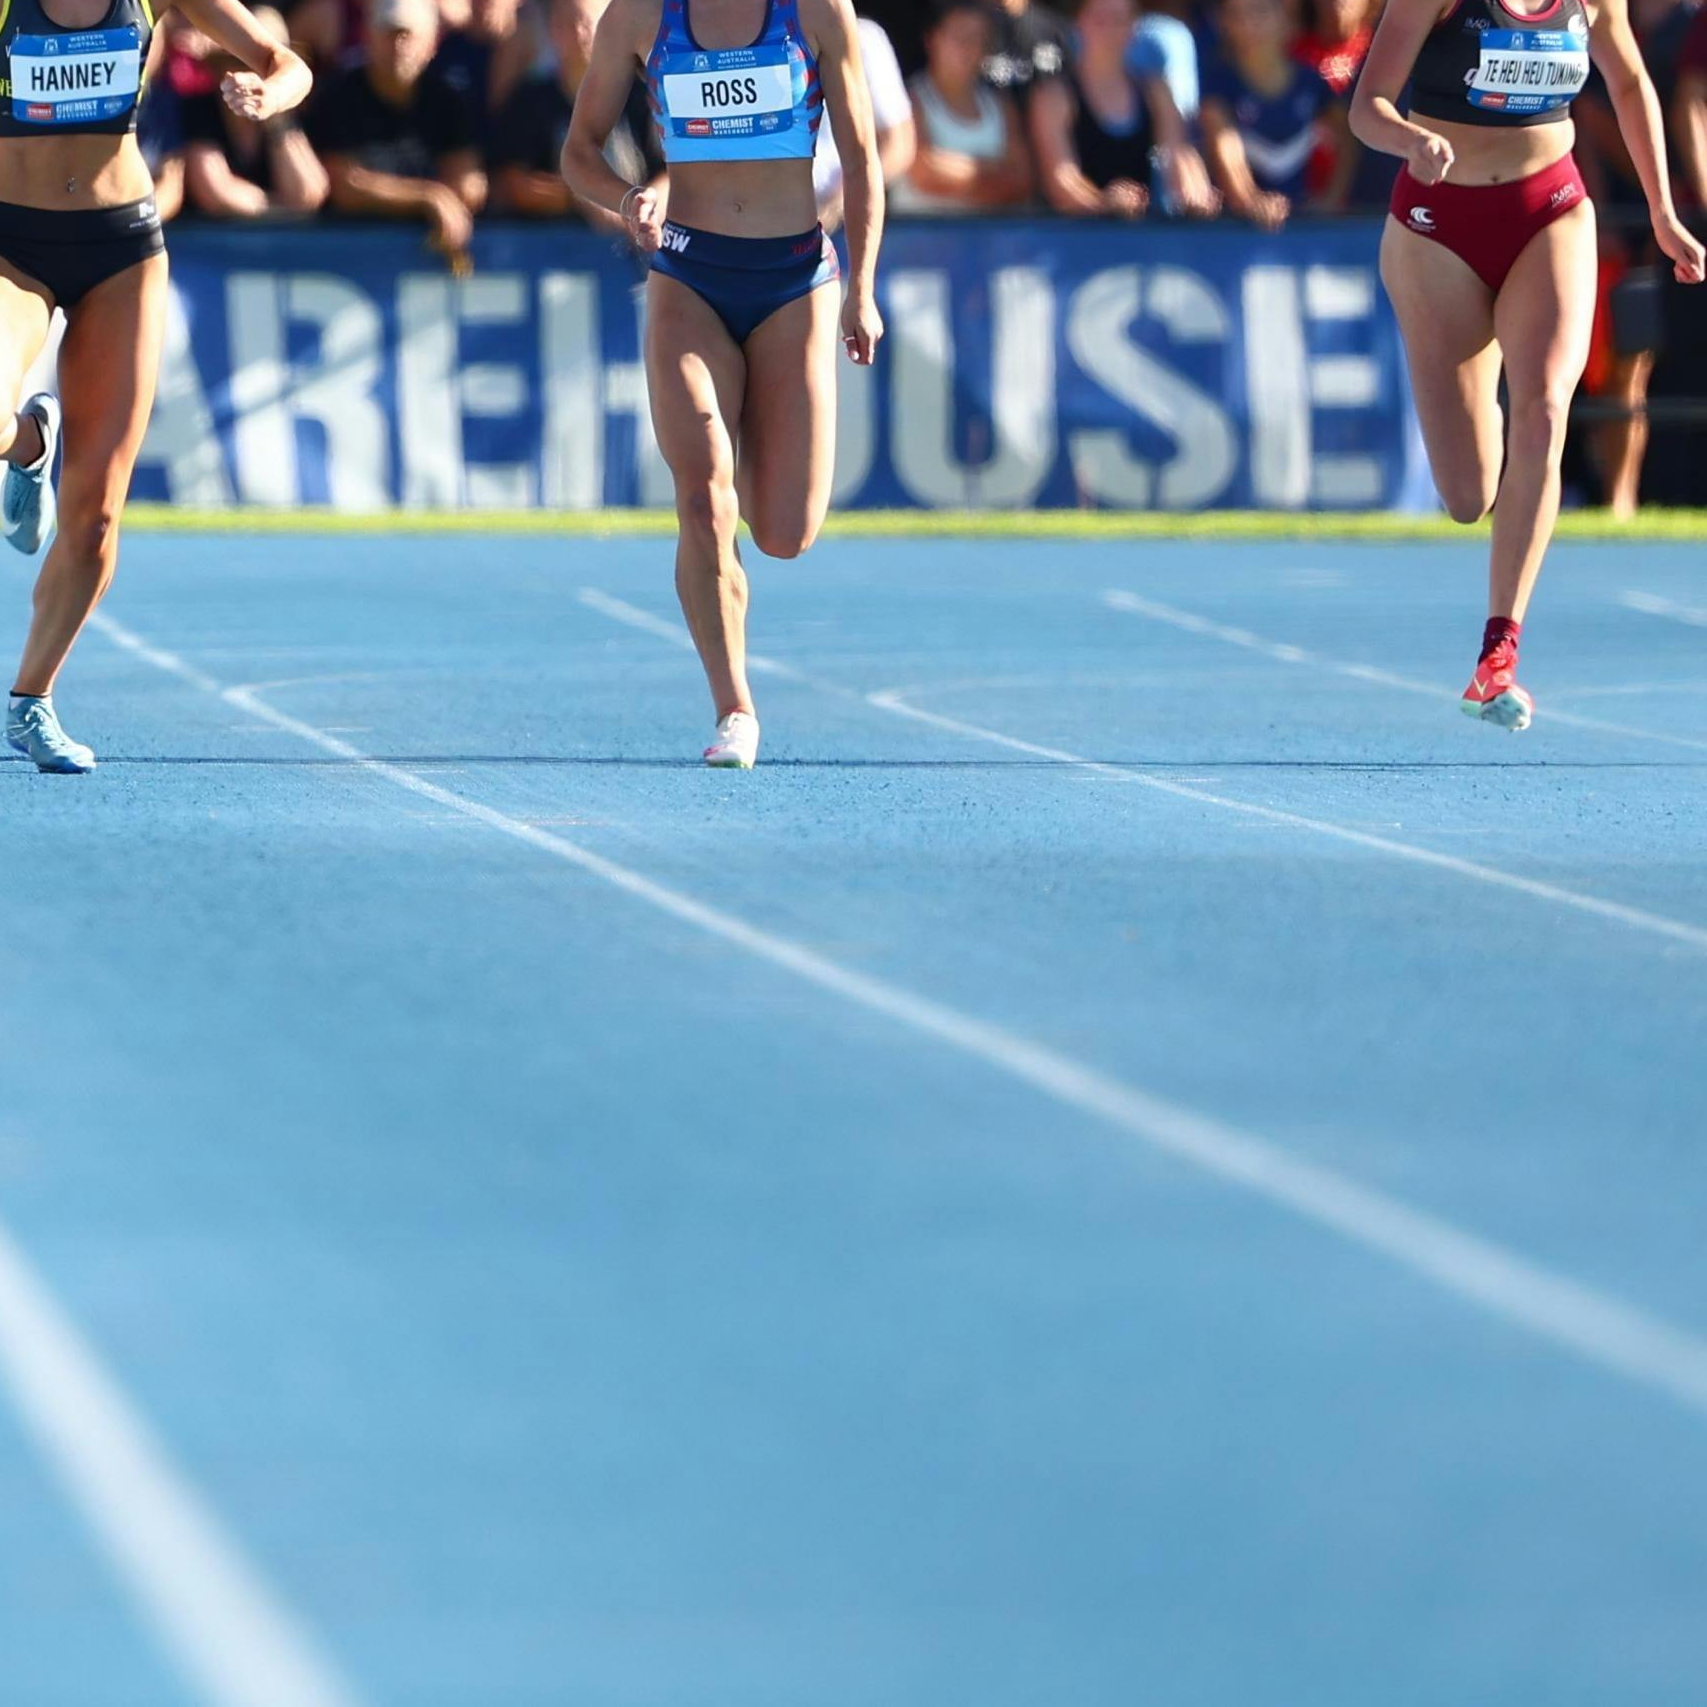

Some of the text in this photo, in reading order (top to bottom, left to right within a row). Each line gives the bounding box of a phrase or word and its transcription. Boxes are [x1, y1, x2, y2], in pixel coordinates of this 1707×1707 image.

[67, 40, 107, 49] AUSTRALIA
[69, 34, 104, 42] WESTERN
[717, 56, 756, 64] AUSTRALIA
[719, 50, 753, 58] WESTERN
[31, 61, 116, 92] HANNEY
[1484, 59, 1499, 83] TE
[1498, 60, 1522, 84] HEU
[1521, 61, 1545, 86] HEU
[701, 78, 757, 107] ROSS
[1508, 95, 1544, 105] CHEMIST
[55, 100, 98, 114] CHEMIST
[712, 117, 754, 130] CHEMIST
[663, 230, 691, 252] SW
